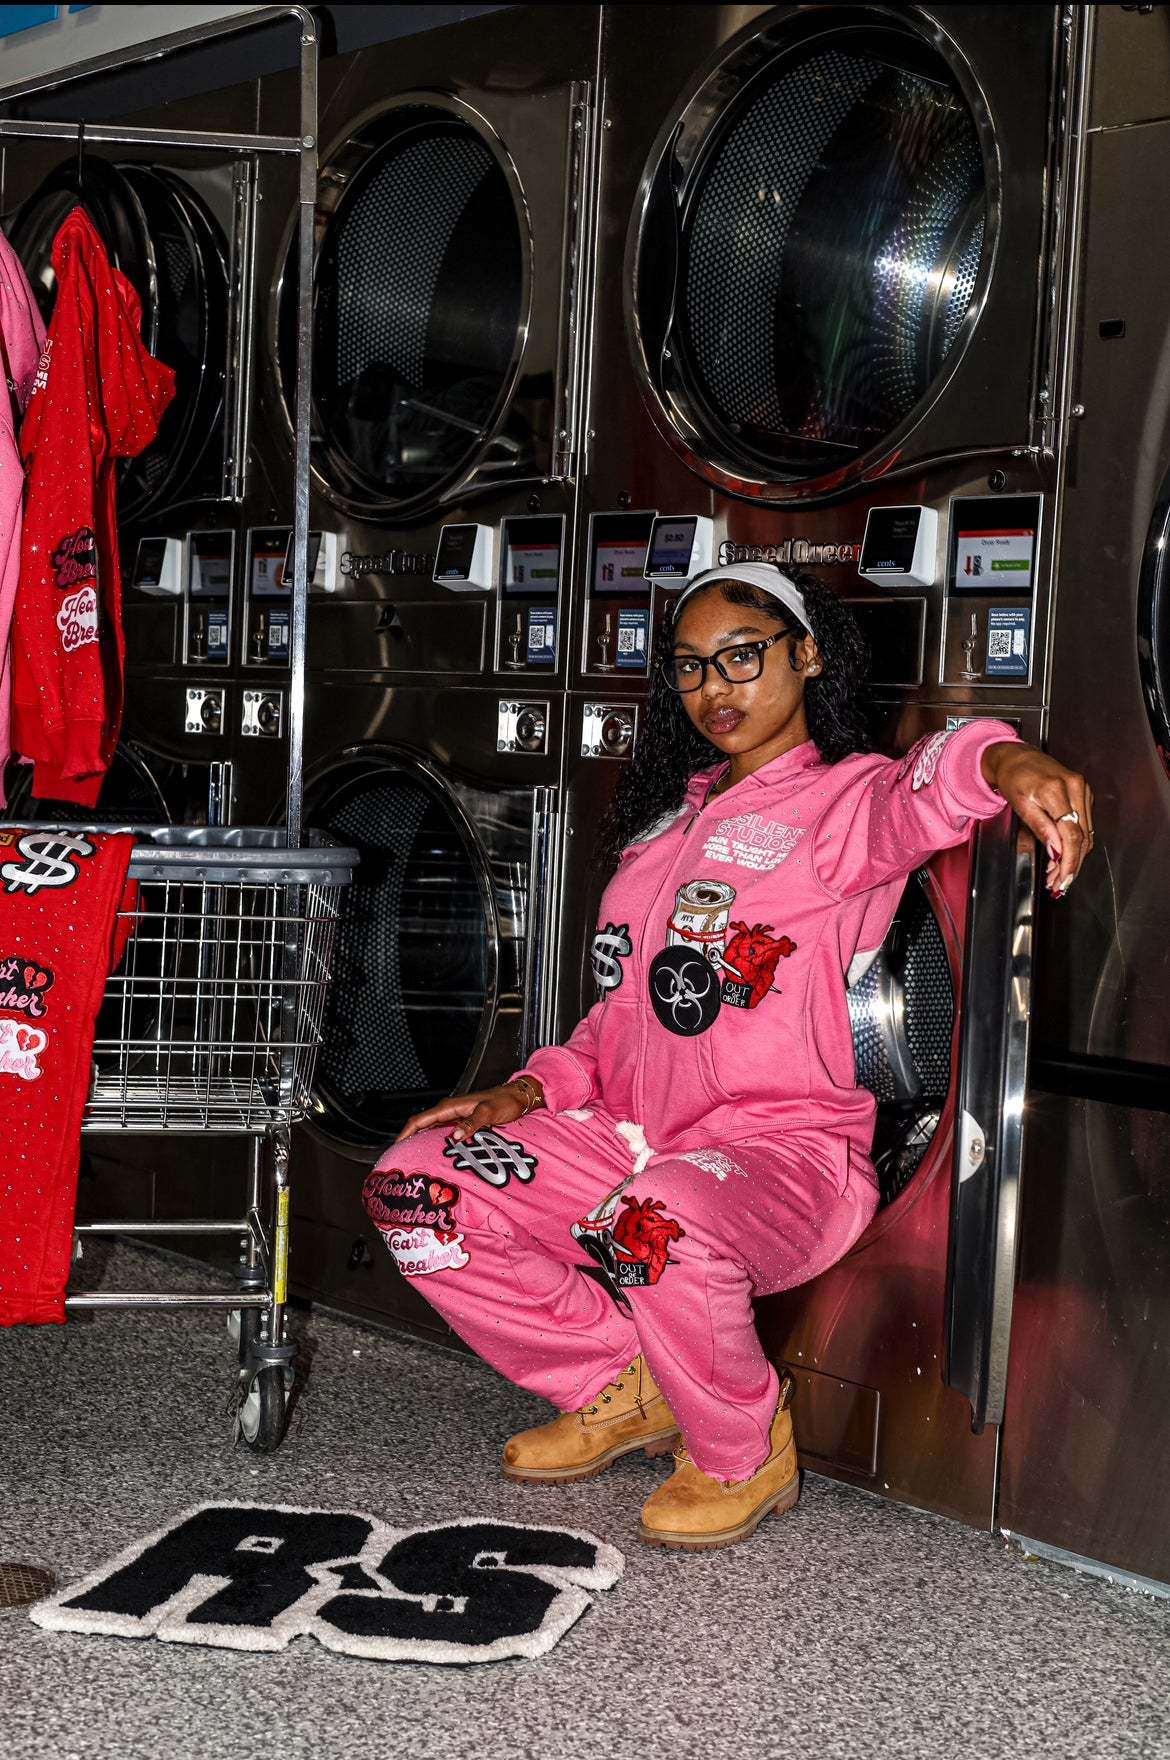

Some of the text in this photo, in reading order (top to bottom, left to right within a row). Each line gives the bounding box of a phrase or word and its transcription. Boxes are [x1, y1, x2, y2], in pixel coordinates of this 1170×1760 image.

[716, 822, 797, 852] STUDIOS
[731, 840, 775, 858] TAUGHT
[732, 849, 763, 863] THAN
[704, 850, 734, 865] EVER
[725, 982, 750, 997] OUT
[722, 994, 746, 1007] ORDER
[364, 1172, 426, 1198] Heart
[367, 1196, 452, 1231] Breaker
[619, 1263, 645, 1275] OUT
[619, 1276, 645, 1285] ORDER
